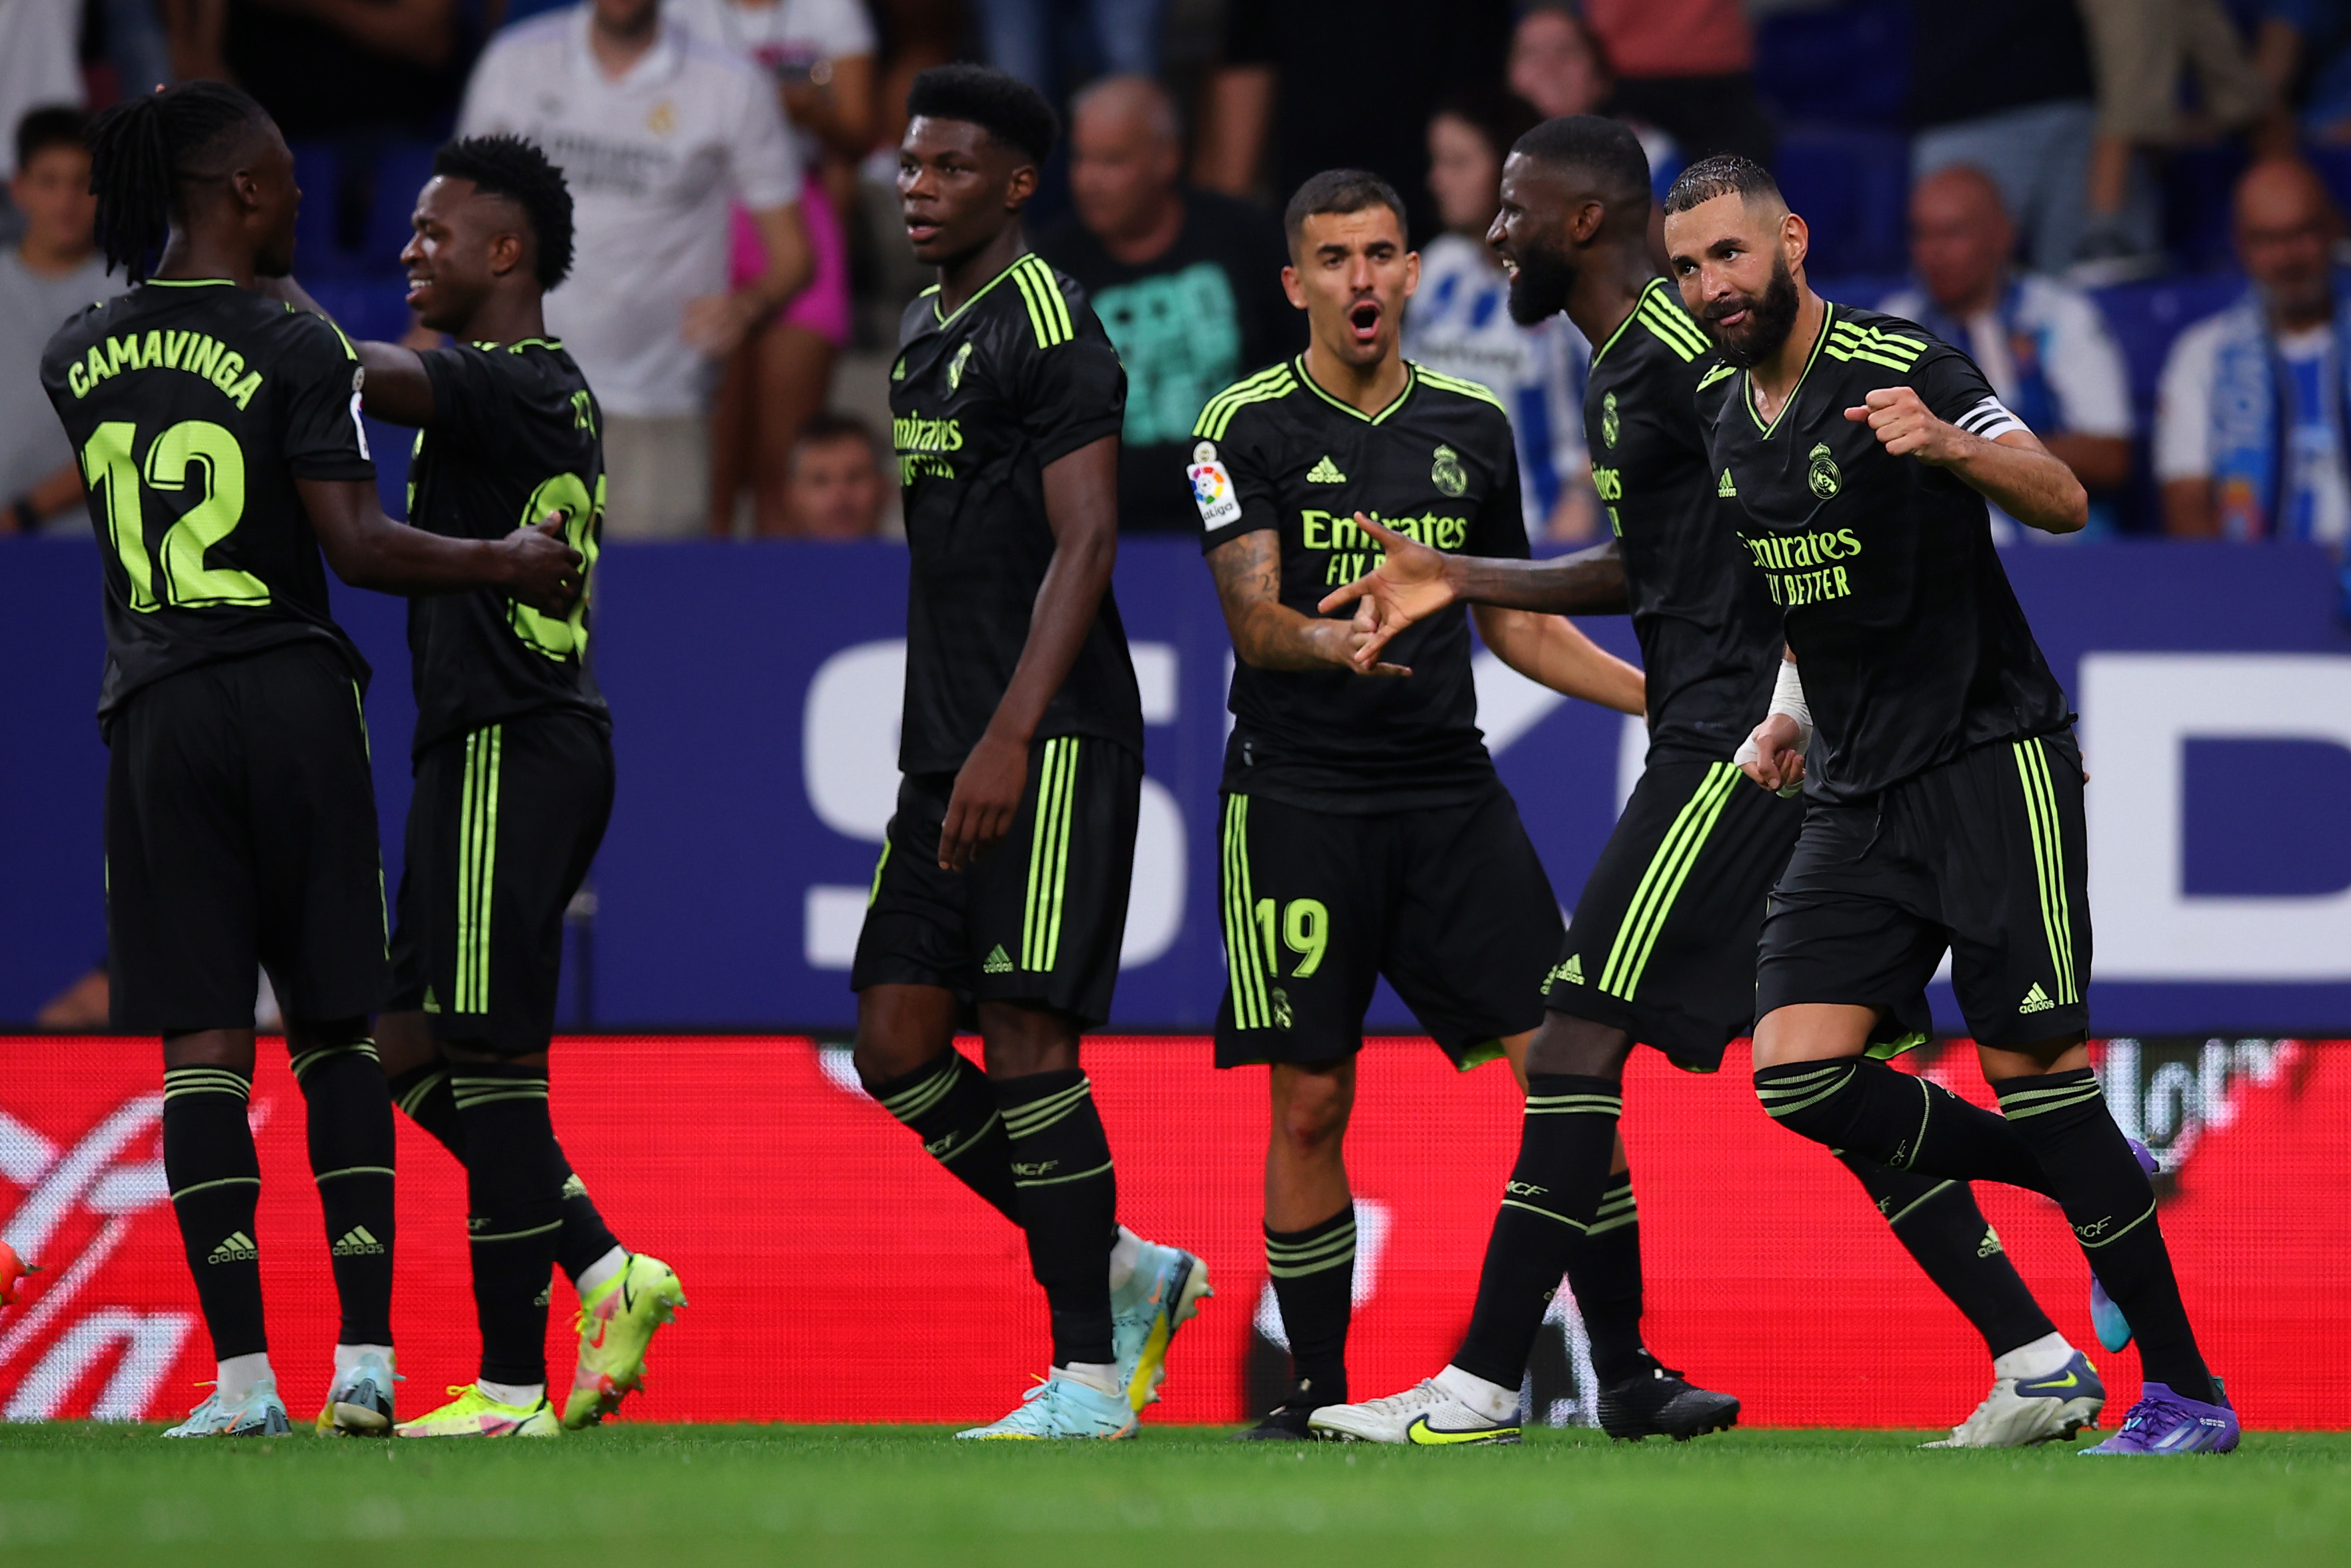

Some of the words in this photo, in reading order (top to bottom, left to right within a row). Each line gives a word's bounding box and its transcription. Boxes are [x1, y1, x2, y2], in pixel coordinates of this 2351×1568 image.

[67, 329, 263, 411] CAMAVINGA
[893, 409, 963, 451] mirates
[81, 419, 271, 613] 12
[1203, 502, 1234, 521] aLiga
[1736, 529, 1862, 569] mirates
[1326, 553, 1366, 586] FLY
[1783, 565, 1851, 605] BETTER
[1255, 898, 1328, 978] 19
[2019, 999, 2056, 1014] adidas
[332, 1243, 384, 1256] adidas
